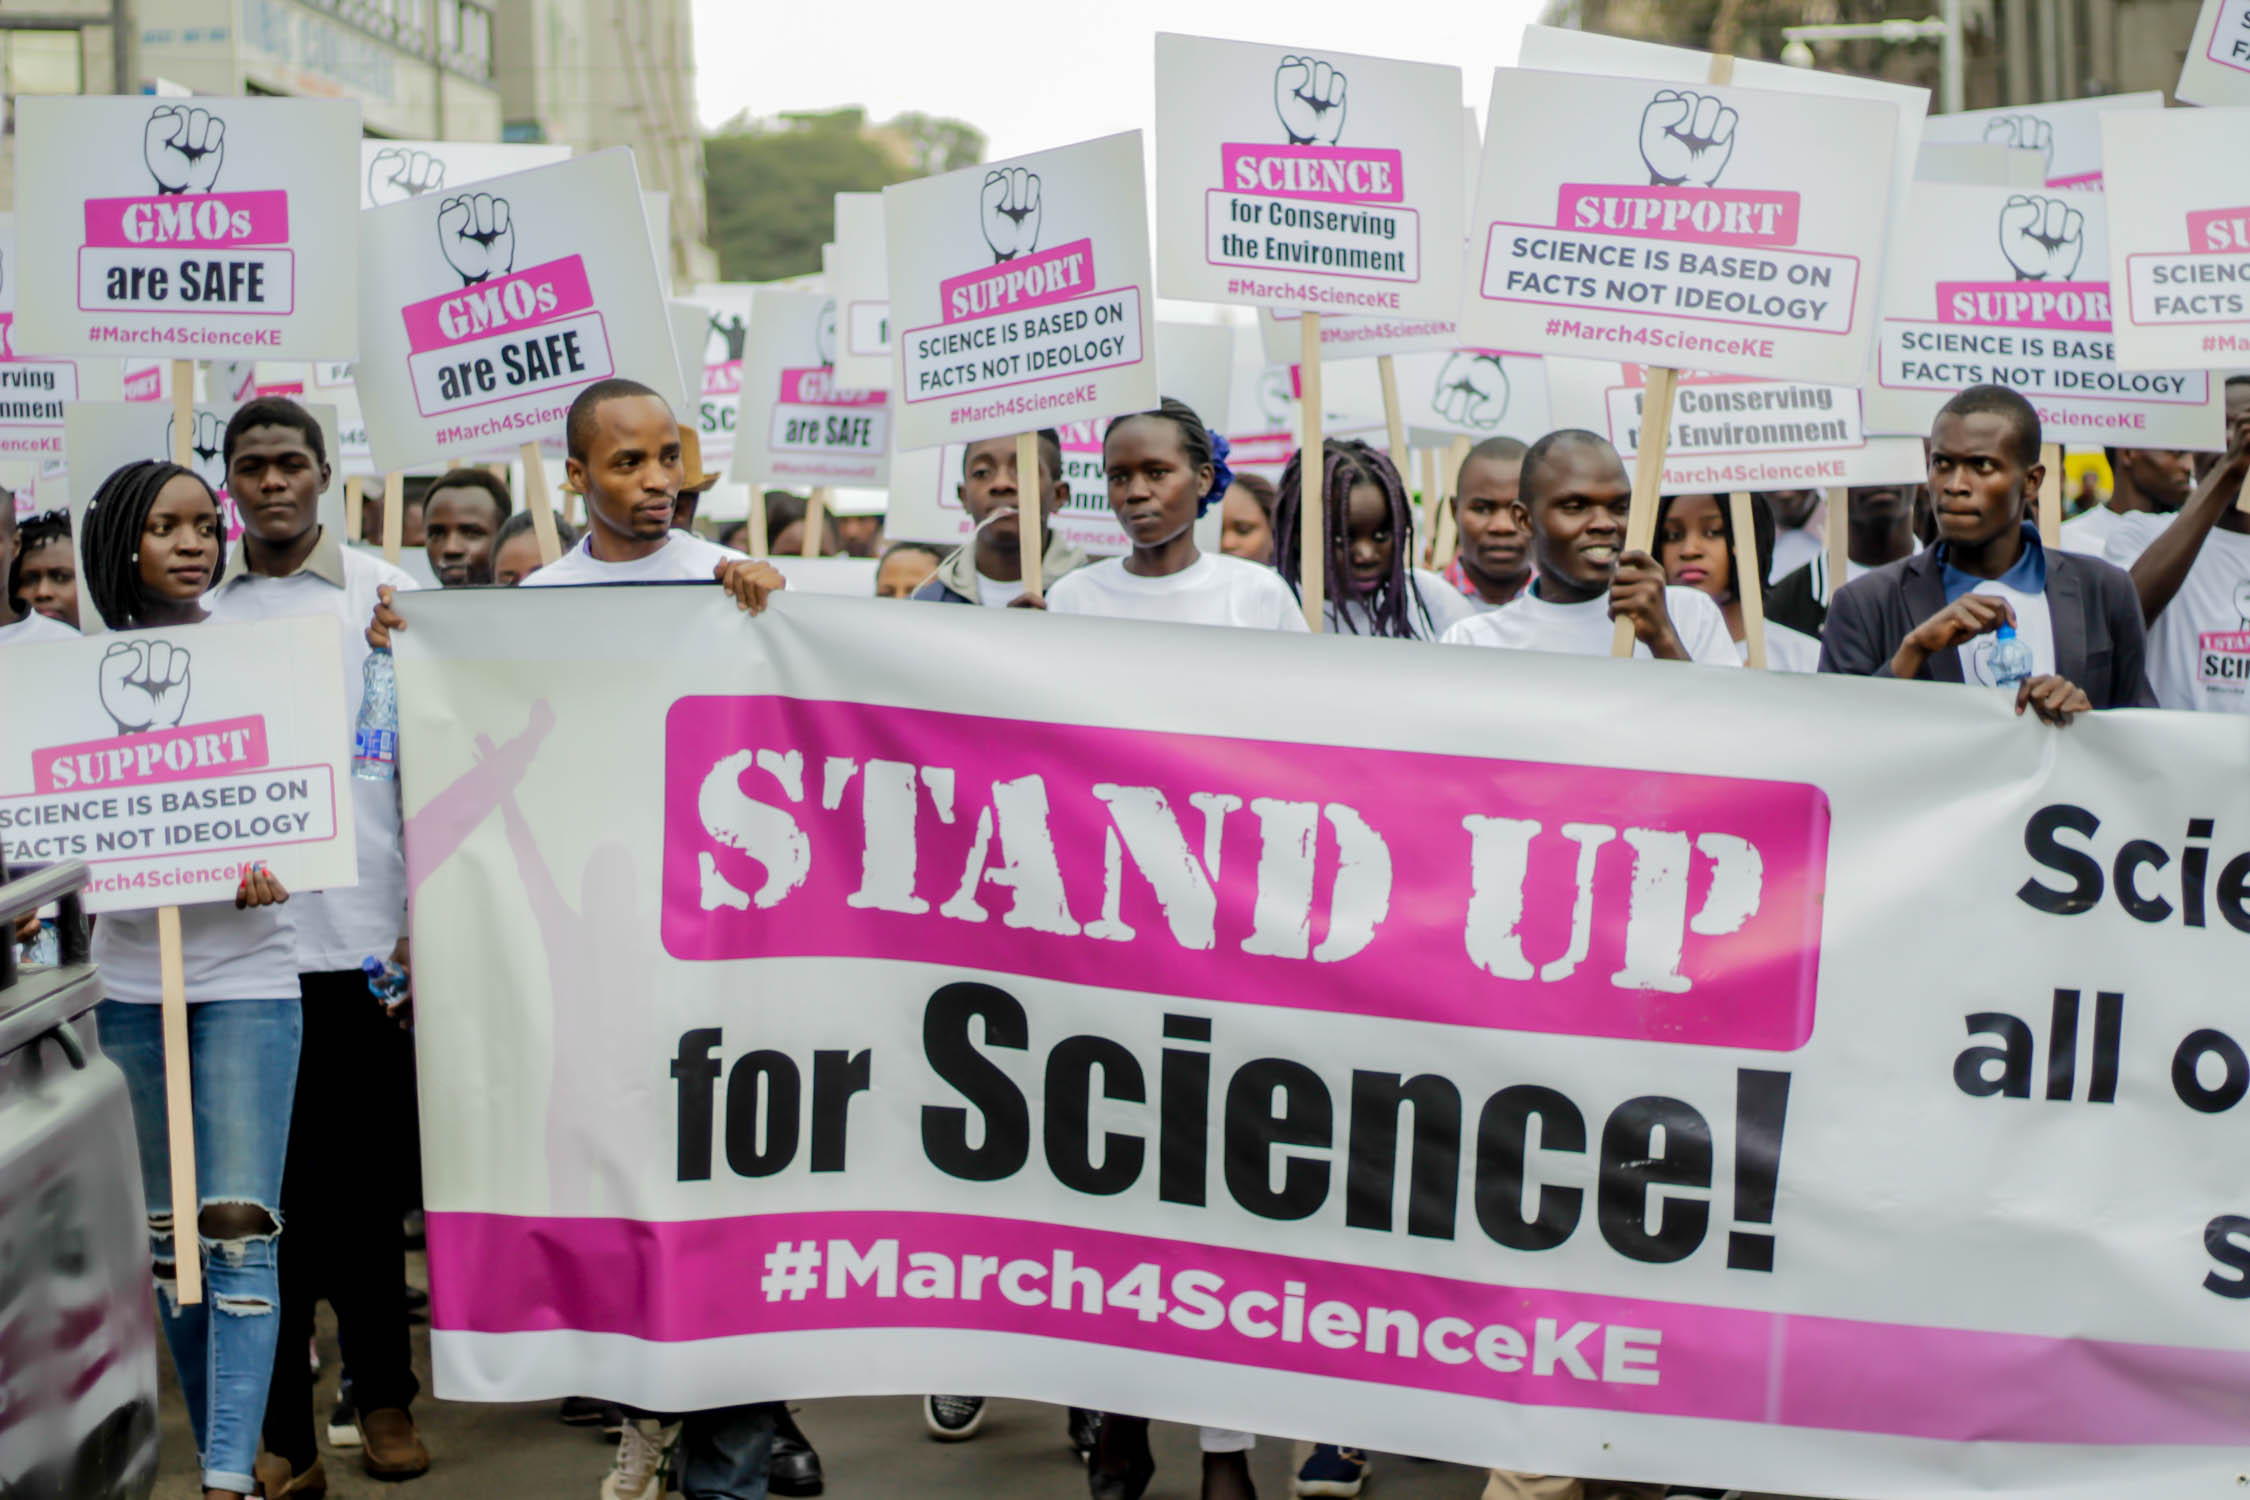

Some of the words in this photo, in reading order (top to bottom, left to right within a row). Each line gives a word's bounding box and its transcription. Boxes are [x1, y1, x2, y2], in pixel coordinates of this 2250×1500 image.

[1235, 156, 1392, 194] SCIENCE
[121, 202, 251, 243] GMOs
[1231, 199, 1262, 223] for
[1270, 203, 1395, 239] Conserving
[1574, 196, 1783, 234] SUPPORT
[1222, 234, 1258, 258] the
[1266, 237, 1406, 272] Environment
[1511, 237, 1635, 267] SCIENCE
[1645, 249, 1669, 271] IS
[1679, 253, 1777, 281] BASED
[1787, 264, 1832, 287] ON
[106, 264, 168, 301] are
[180, 261, 264, 302] SAFE
[952, 253, 1084, 318] SUPPORT
[1228, 280, 1399, 308] #March4ScienceKE
[1506, 271, 1596, 297] FACTS
[1606, 280, 1666, 304] NOT
[1675, 286, 1828, 321] IDEOLOGY
[438, 279, 558, 340] GMOs
[1953, 292, 2111, 322] SUPPOR
[2154, 294, 2243, 315] FACTS
[89, 326, 282, 346] #March4ScienceKE
[919, 327, 996, 359] SCIENCE
[1002, 323, 1018, 344] IS
[1024, 310, 1088, 340] BASED
[1095, 302, 1123, 325] ON
[1545, 319, 1775, 358] #March4ScienceKE
[1902, 332, 2013, 354] SCIENCE
[2022, 339, 2044, 356] IS
[2053, 340, 2114, 360] BASE
[438, 357, 496, 401] are
[501, 331, 585, 386] SAFE
[920, 363, 976, 391] FACTS
[983, 356, 1020, 380] NOT
[1027, 335, 1125, 372] IDEOLOGY
[1902, 362, 1982, 383] FACTS
[1993, 367, 2045, 386] NOT
[2055, 370, 2185, 394] IDEOLOGY
[951, 384, 1096, 424] #March4ScienceKE
[1680, 387, 1832, 414] Conserving
[2037, 407, 2146, 429] ScienceKE
[785, 419, 820, 444] are
[826, 415, 872, 447] SAFE
[1680, 419, 1848, 447] Environment
[1662, 460, 1846, 485] March4ScienceKE
[51, 728, 250, 789] SUPPORT
[0, 800, 118, 829] SCIENCE
[128, 796, 152, 816] IS
[162, 785, 257, 813] BASED
[266, 780, 308, 802] ON
[96, 828, 154, 852] NOT
[165, 812, 310, 845] IDEOLOGY
[697, 747, 1392, 963] STAND
[1461, 812, 1763, 993] UP
[1953, 988, 2124, 1104] all
[2171, 1028, 2250, 1114] o
[669, 1027, 872, 1183] for
[920, 981, 1793, 1275] Science!
[760, 1237, 1662, 1386] #March4ScienceKE
